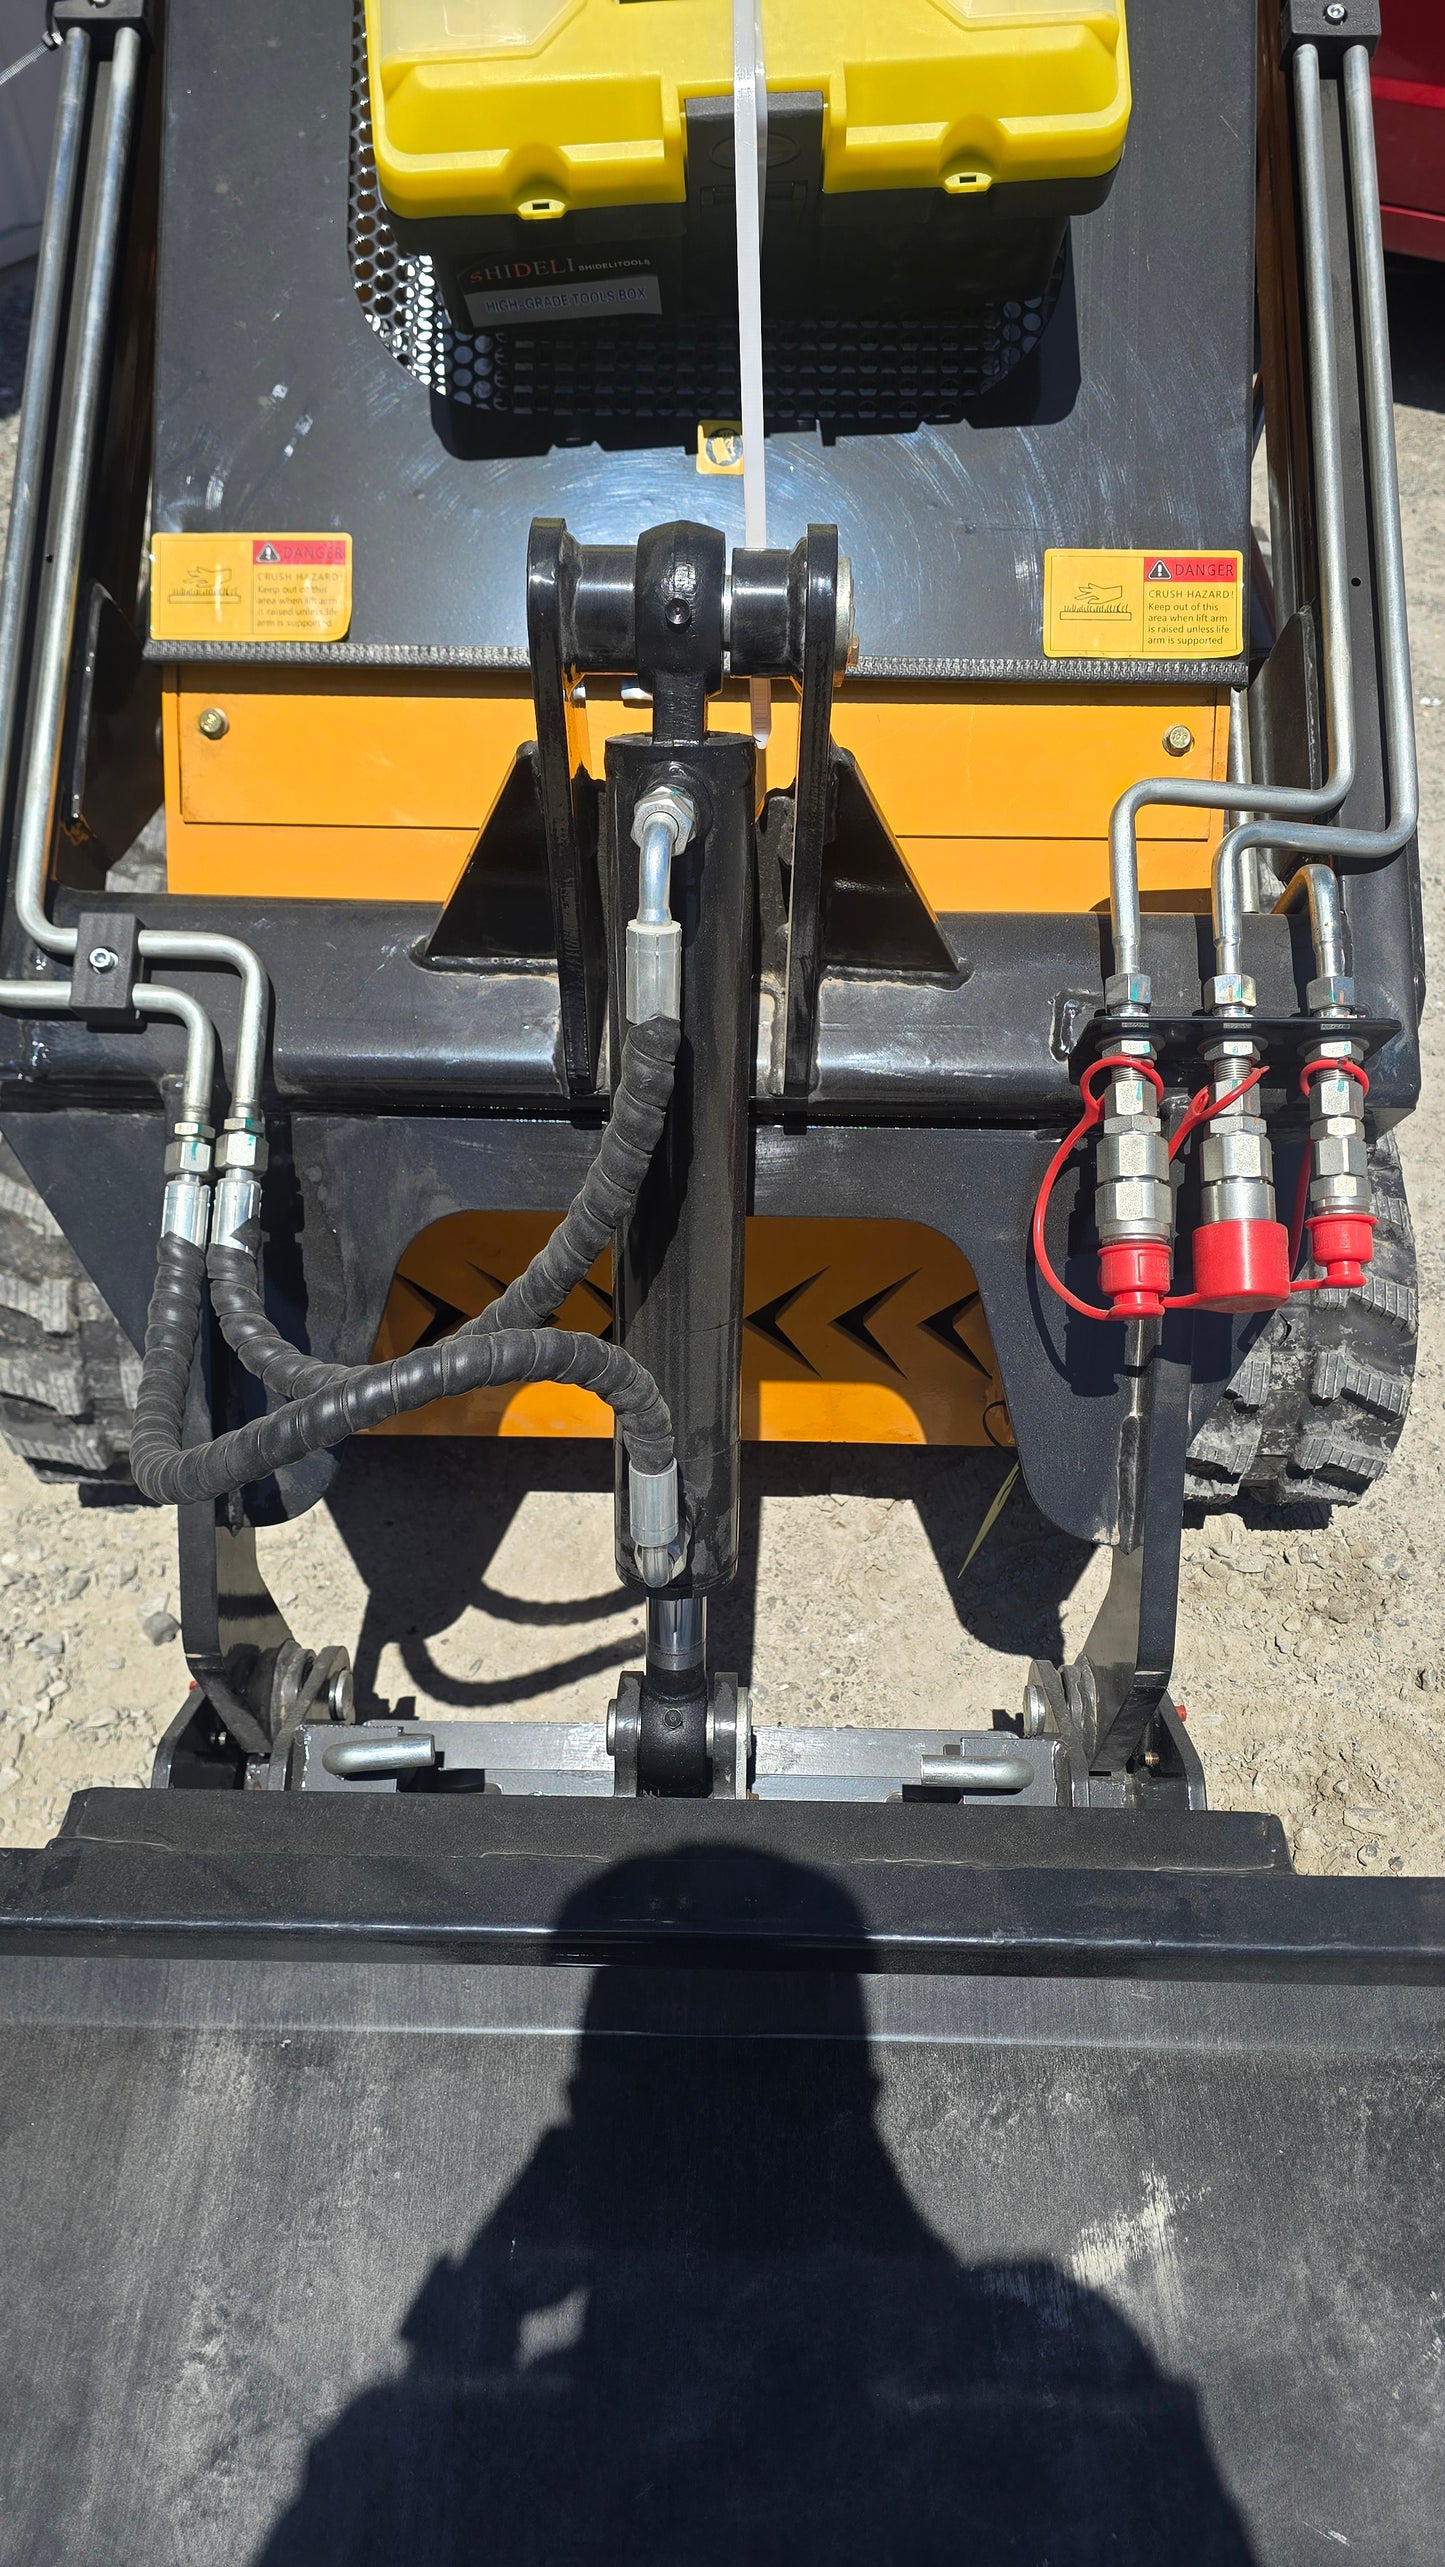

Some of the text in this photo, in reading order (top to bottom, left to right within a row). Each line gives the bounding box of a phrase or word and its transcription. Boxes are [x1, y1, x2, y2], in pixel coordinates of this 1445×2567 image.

[578, 259, 651, 272] SHIDELITOOLS
[486, 287, 648, 313] HIGH-GRADE TOOLS BOX
[282, 546, 343, 560] DANGER
[1175, 564, 1234, 576] DANGER
[257, 572, 292, 581] CRUSH
[258, 585, 280, 595] Keep
[311, 585, 328, 593] this
[1148, 589, 1234, 599] CRUSH HAZARD!
[279, 596, 303, 605] when
[267, 608, 294, 616] raised
[1148, 603, 1219, 612] Keep out of this
[1169, 614, 1194, 622] when
[1196, 614, 1208, 622] lift
[278, 619, 284, 627] is
[1148, 625, 1155, 633] is
[1157, 625, 1184, 633] raised
[1177, 636, 1223, 646] supported
